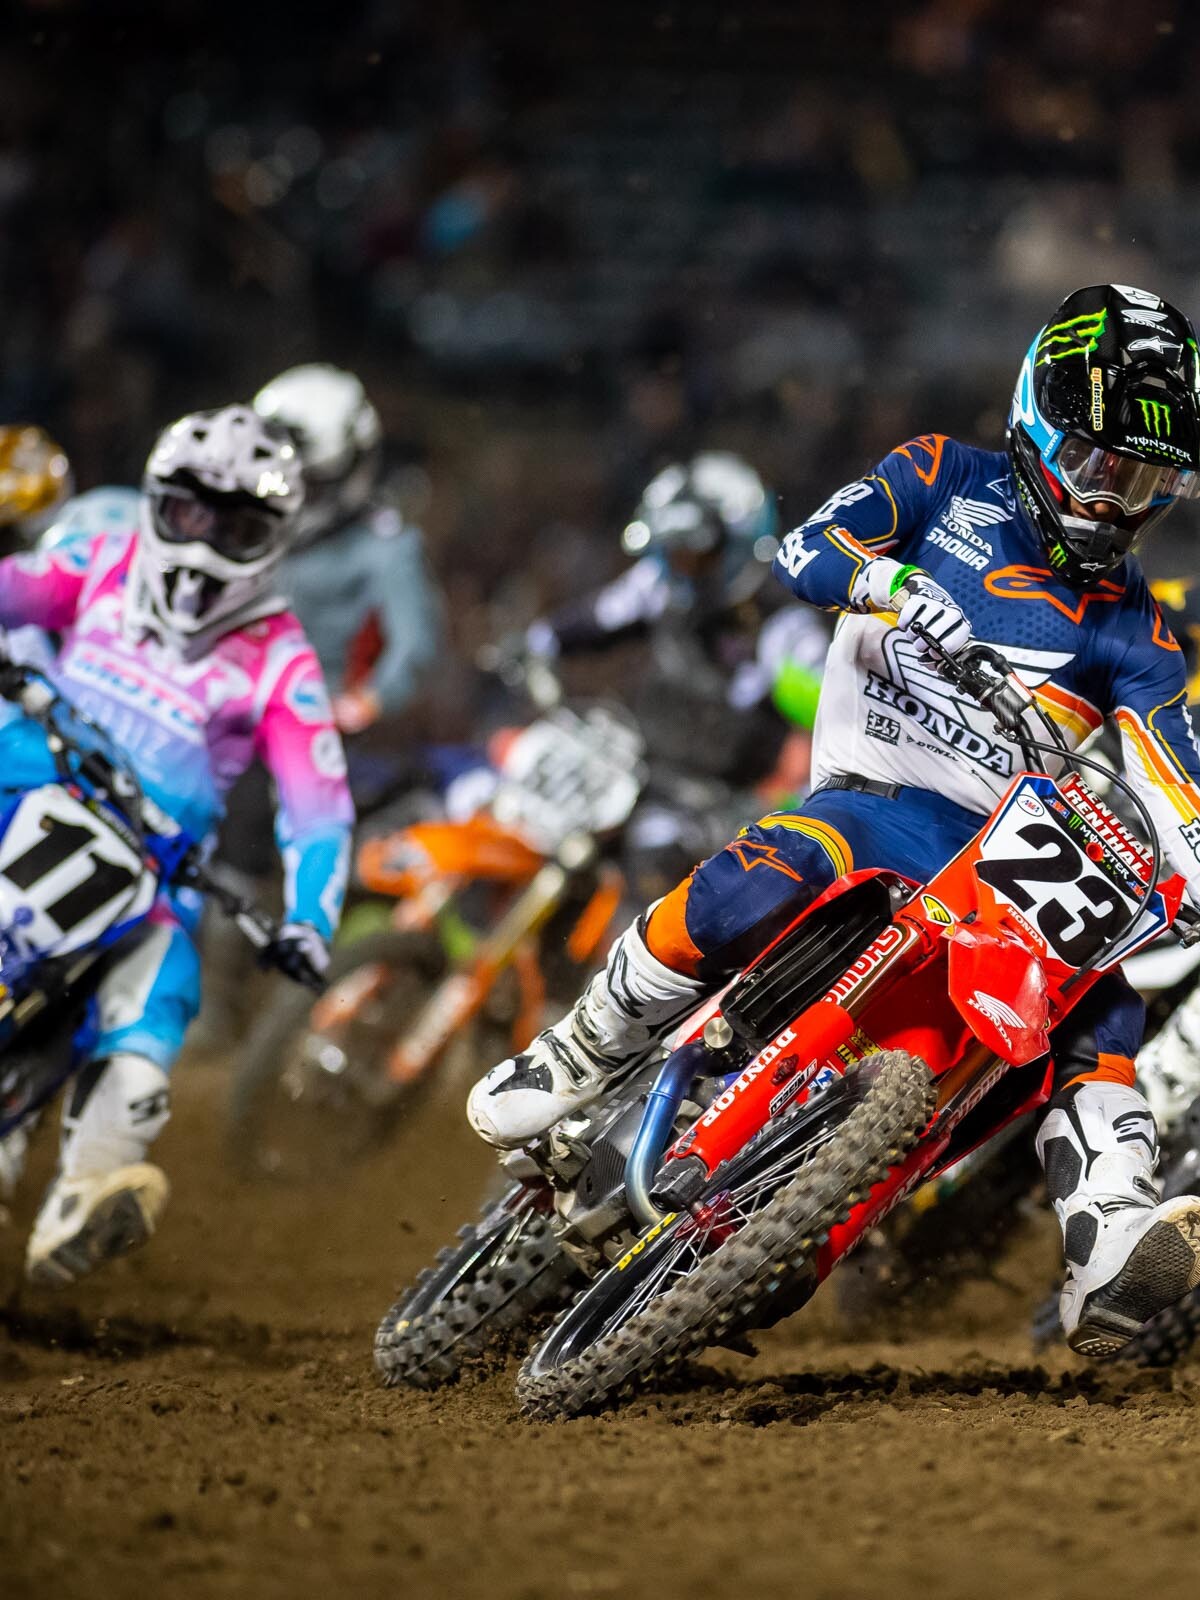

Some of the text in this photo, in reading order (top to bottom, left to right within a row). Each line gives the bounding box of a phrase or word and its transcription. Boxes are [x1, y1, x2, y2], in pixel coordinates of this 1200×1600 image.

[1122, 317, 1177, 337] HONDA
[1092, 368, 1104, 431] apdesigns
[1043, 434, 1059, 458] OAKLEY
[1125, 435, 1193, 462] MONSTER
[926, 527, 990, 571] SHOWA
[940, 511, 994, 556] HONDA
[864, 669, 1014, 779] HONDA
[1066, 788, 1144, 877] RENTHAL
[1076, 777, 1155, 866] RENTHAL
[1, 814, 138, 934] 11
[975, 823, 1134, 968] 23
[1006, 905, 1045, 948] HONDA
[967, 998, 1013, 1051] HONDA
[702, 1027, 799, 1128] DUNLOP
